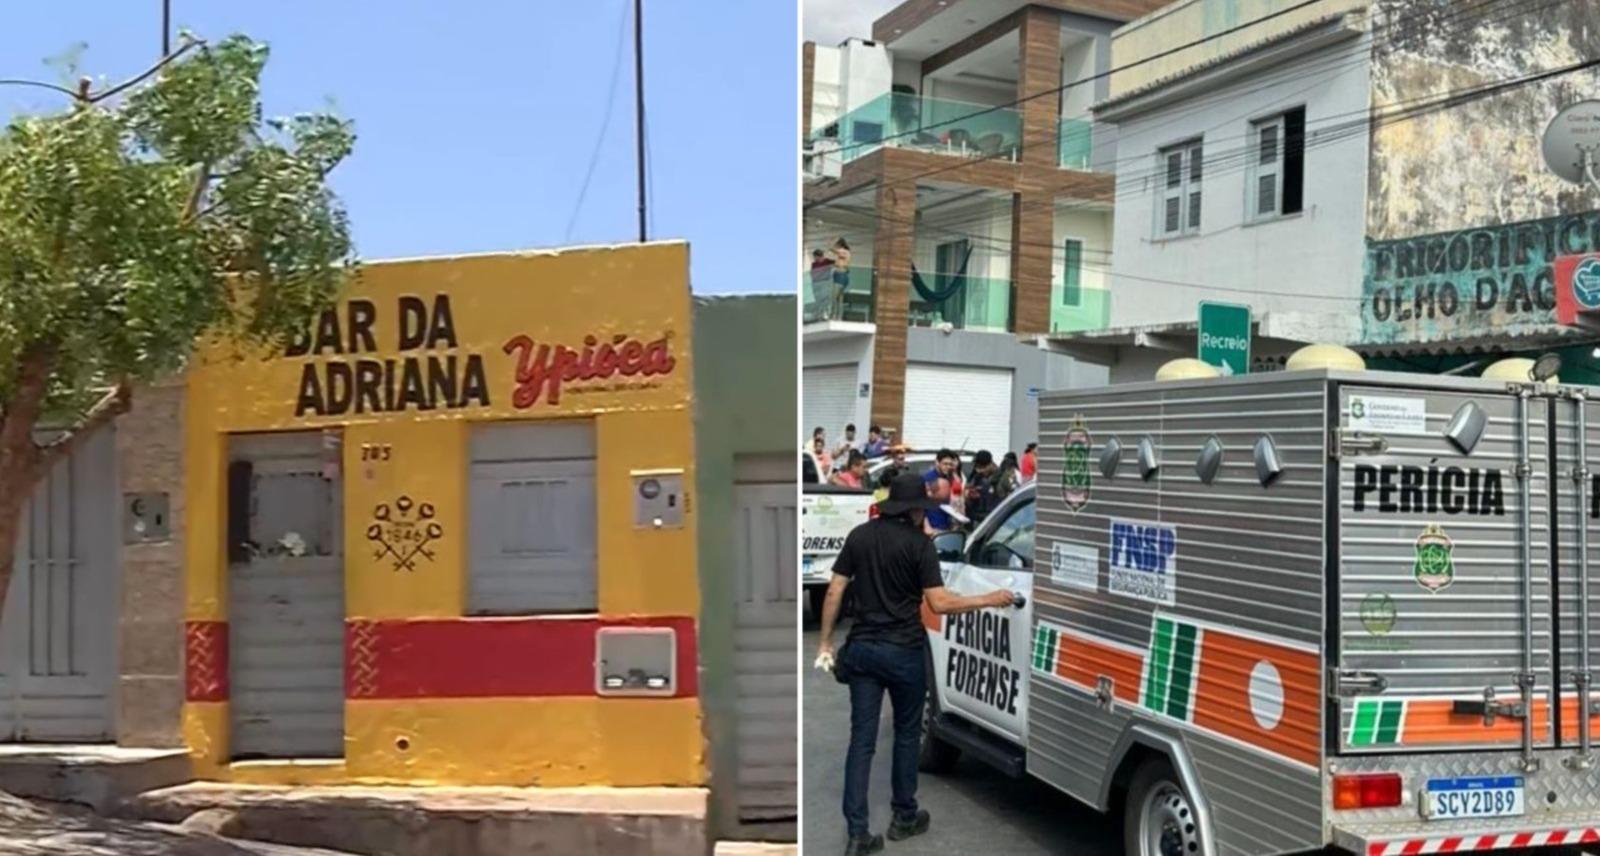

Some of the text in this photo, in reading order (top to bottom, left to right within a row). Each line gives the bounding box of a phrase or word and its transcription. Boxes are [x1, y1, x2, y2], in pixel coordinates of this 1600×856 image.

[1373, 214, 1600, 282] FRIGORIFIC
[398, 293, 458, 351] DA
[1373, 265, 1557, 322] OLHO D'AG
[1201, 332, 1247, 351] Recreio
[294, 354, 491, 418] ADRIANA
[502, 334, 676, 409] Ypióca
[1353, 458, 1505, 516] PERÍCIA
[802, 536, 845, 551] ORENS
[1111, 523, 1175, 575] FNSP
[946, 647, 1020, 716] FORENSE
[1437, 789, 1516, 815] SCY2D89
